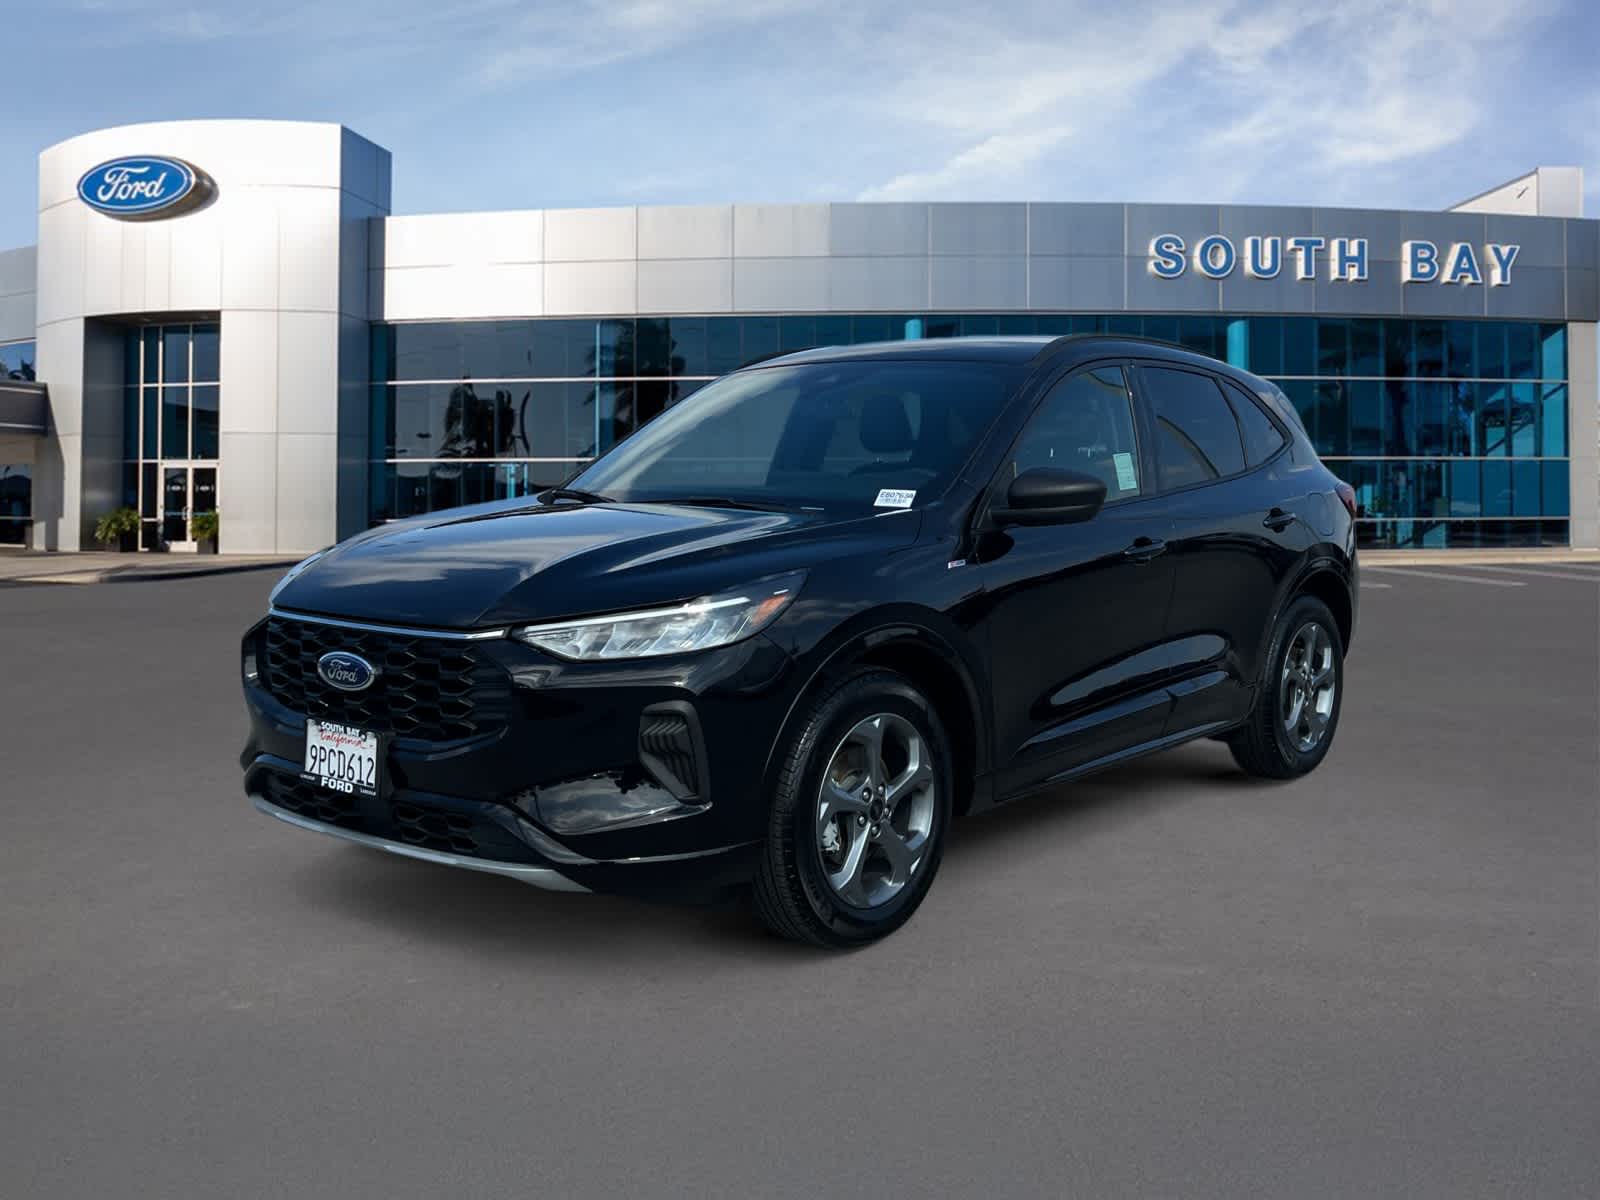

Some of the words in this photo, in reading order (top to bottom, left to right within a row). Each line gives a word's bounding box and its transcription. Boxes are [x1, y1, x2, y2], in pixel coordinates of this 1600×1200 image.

[96, 166, 168, 202] Ford
[1148, 233, 1369, 281] SOUTH
[1401, 240, 1521, 288] BAY
[327, 659, 358, 682] Ford
[321, 721, 344, 733] SOUTH
[347, 727, 361, 738] BAY
[310, 744, 374, 787] 9PCD612
[321, 776, 353, 793] FORD
